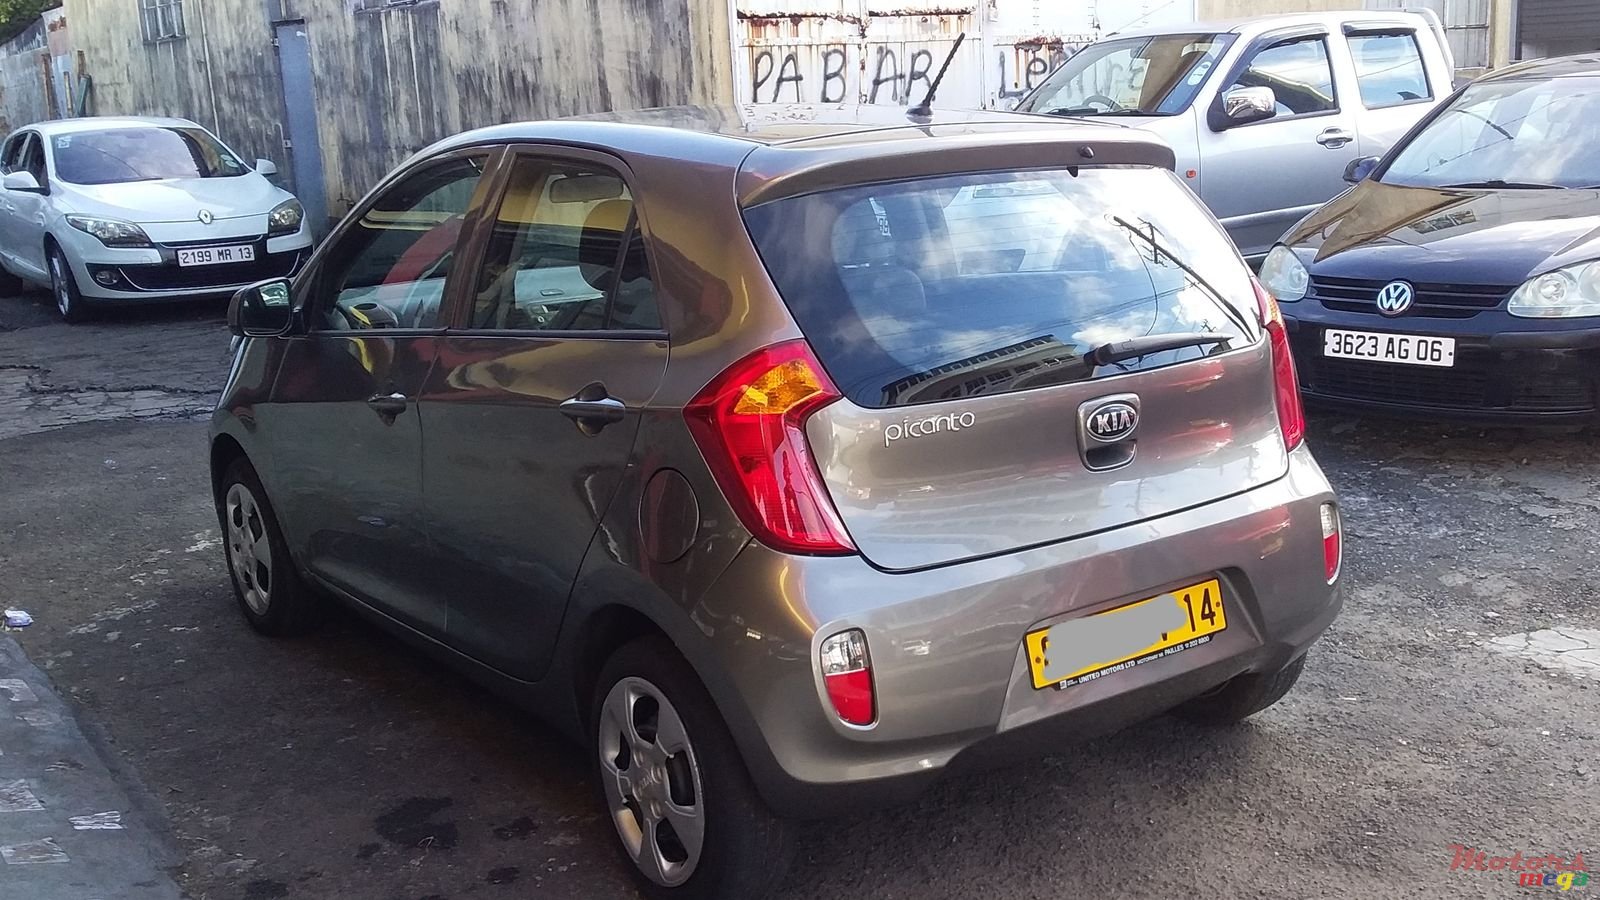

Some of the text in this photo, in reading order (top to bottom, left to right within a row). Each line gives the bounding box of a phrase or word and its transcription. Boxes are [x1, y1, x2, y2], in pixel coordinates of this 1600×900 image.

[752, 51, 803, 103] PA
[181, 247, 252, 264] 2199 MR 13
[1331, 332, 1442, 362] 3623 AG 06
[884, 411, 976, 448] picanto
[1095, 409, 1132, 435] KIA
[1078, 671, 1100, 684] UNITED
[1100, 663, 1125, 677] MOTORS
[1124, 660, 1136, 670] LTD
